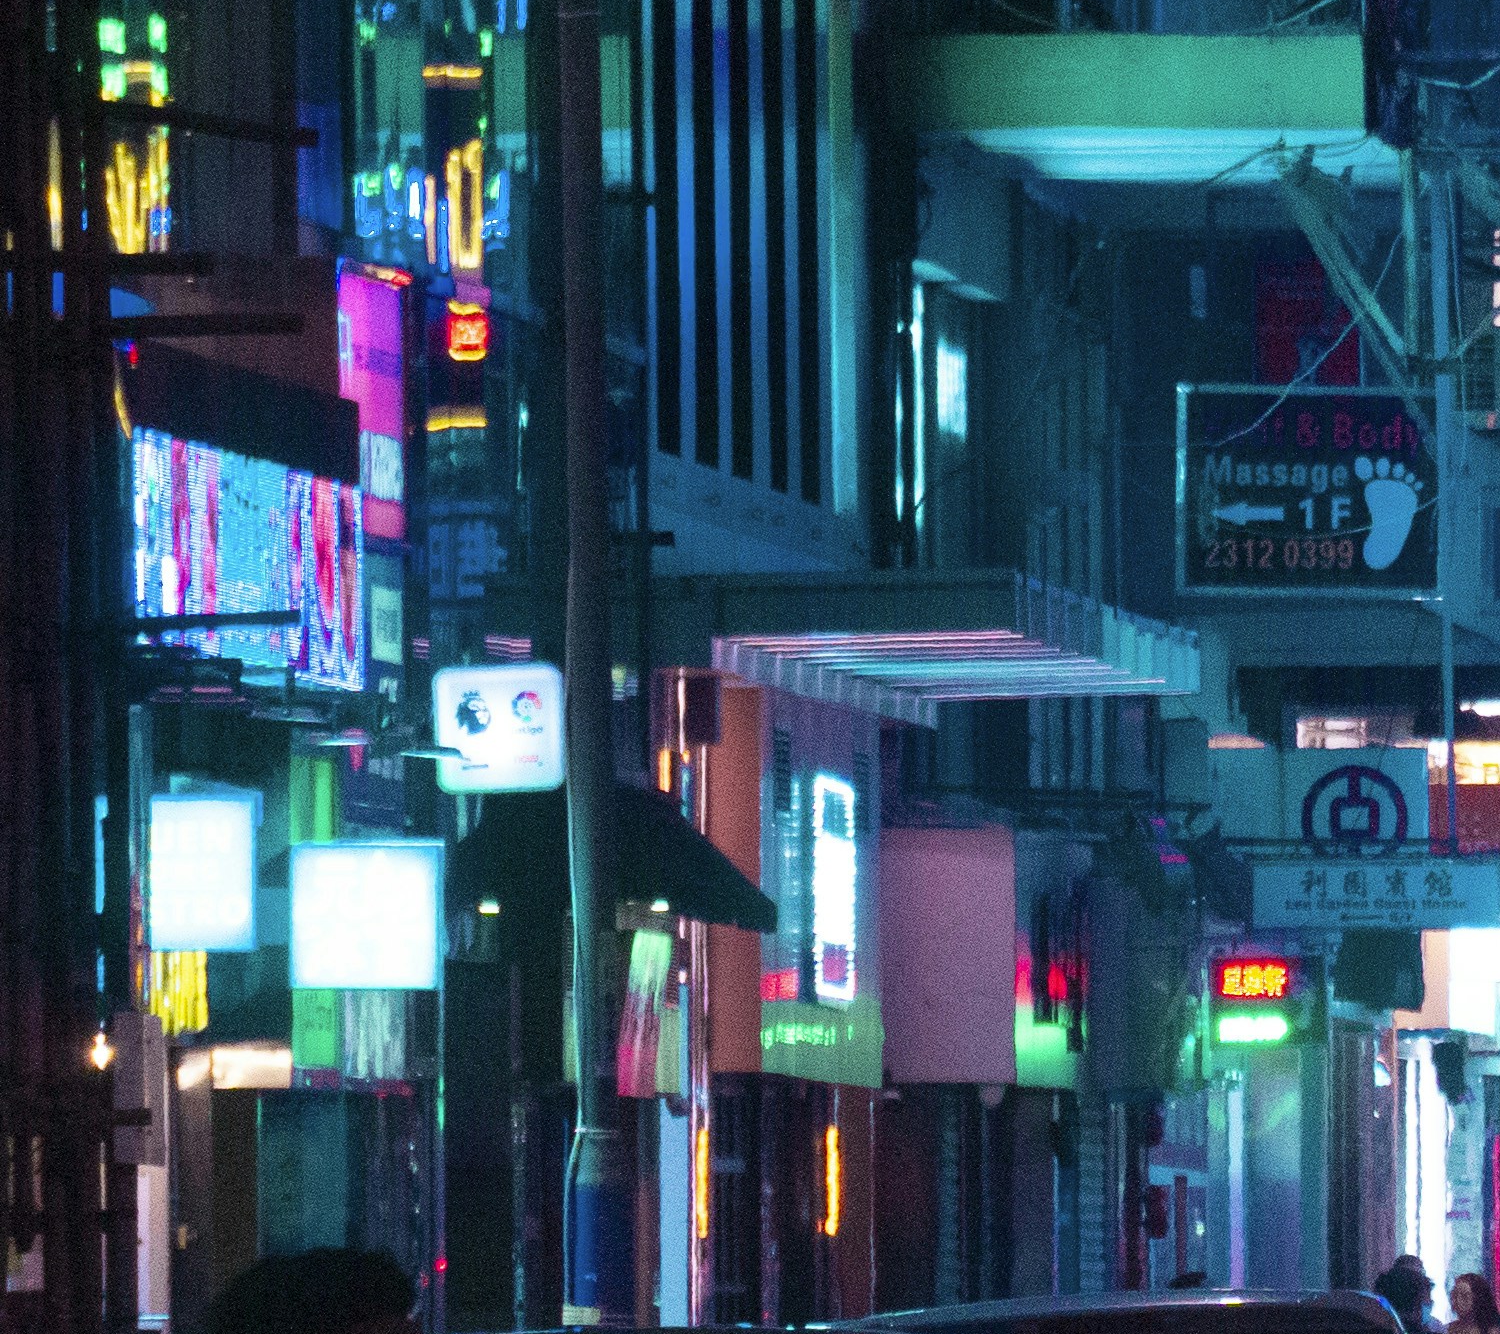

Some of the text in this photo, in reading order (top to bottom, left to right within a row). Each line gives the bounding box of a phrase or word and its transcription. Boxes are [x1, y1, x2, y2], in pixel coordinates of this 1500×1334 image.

[1202, 455, 1349, 493] Massage
[1203, 539, 1354, 568] 2312 0399
